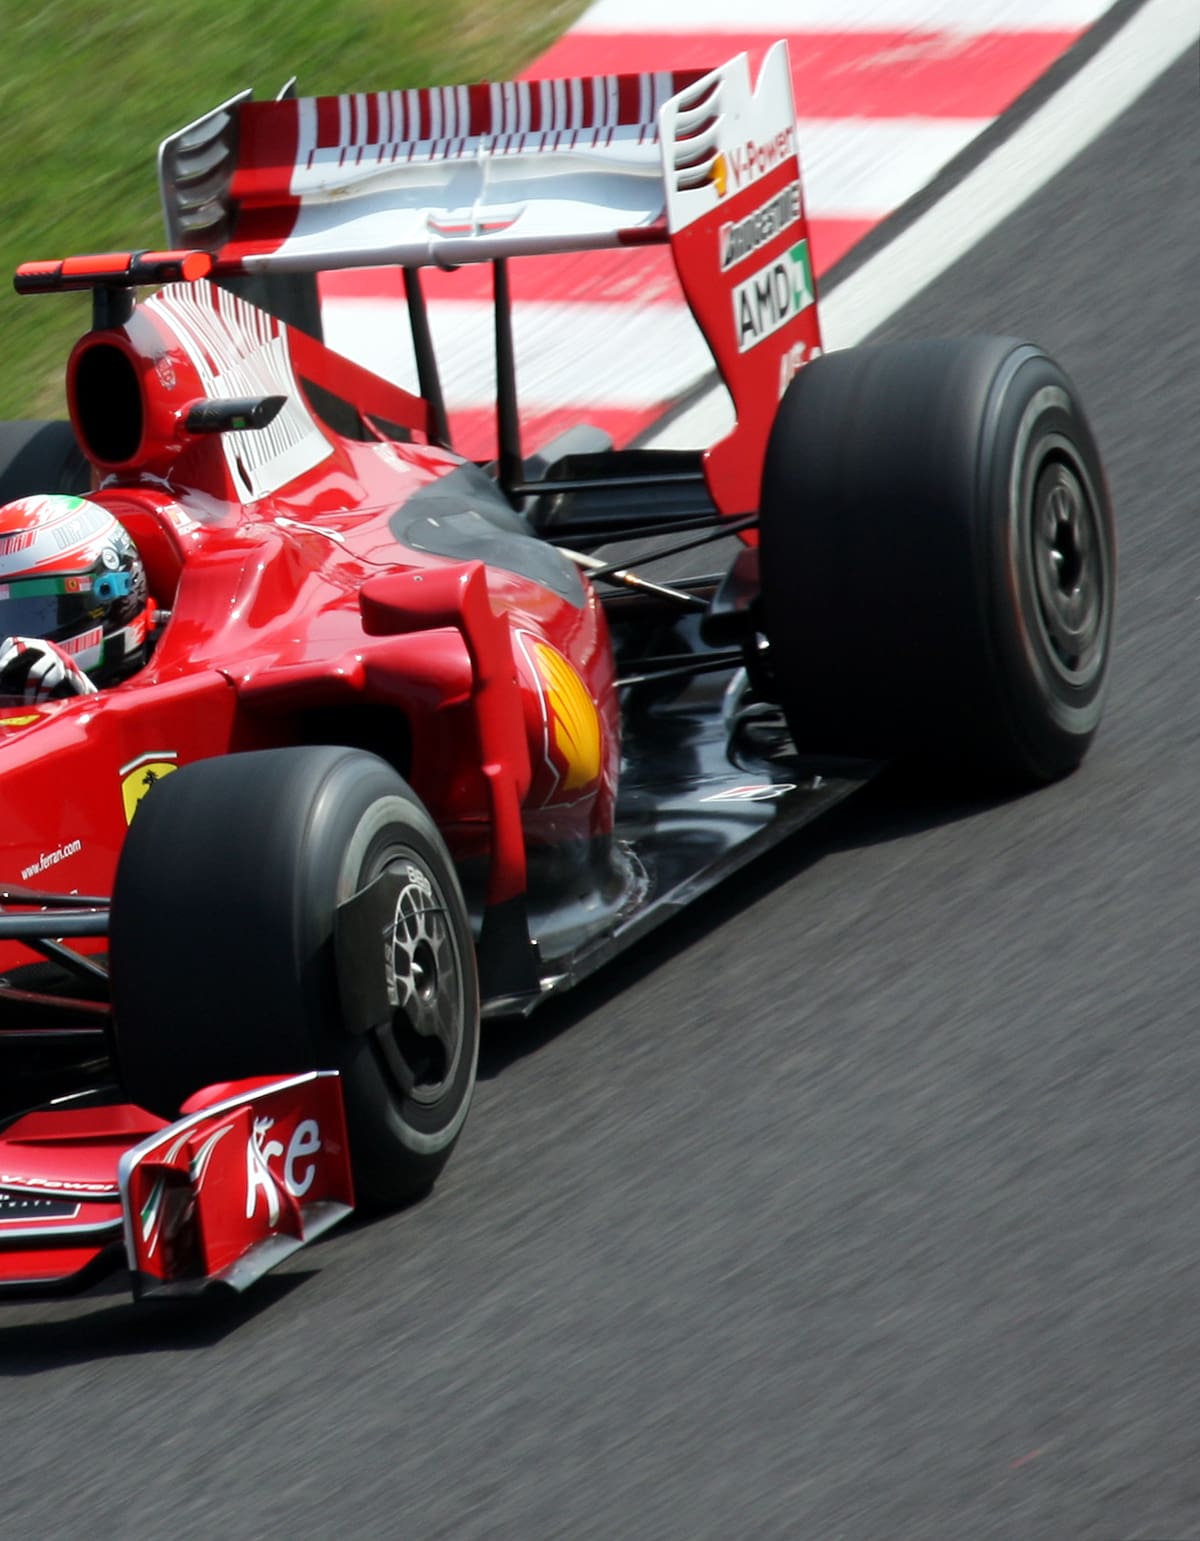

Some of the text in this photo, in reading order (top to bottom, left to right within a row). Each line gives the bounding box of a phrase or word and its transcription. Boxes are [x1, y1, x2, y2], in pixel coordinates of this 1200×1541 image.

[728, 127, 793, 188] V-Power
[738, 264, 791, 347] AMD
[20, 839, 82, 881] www.ferrari.com
